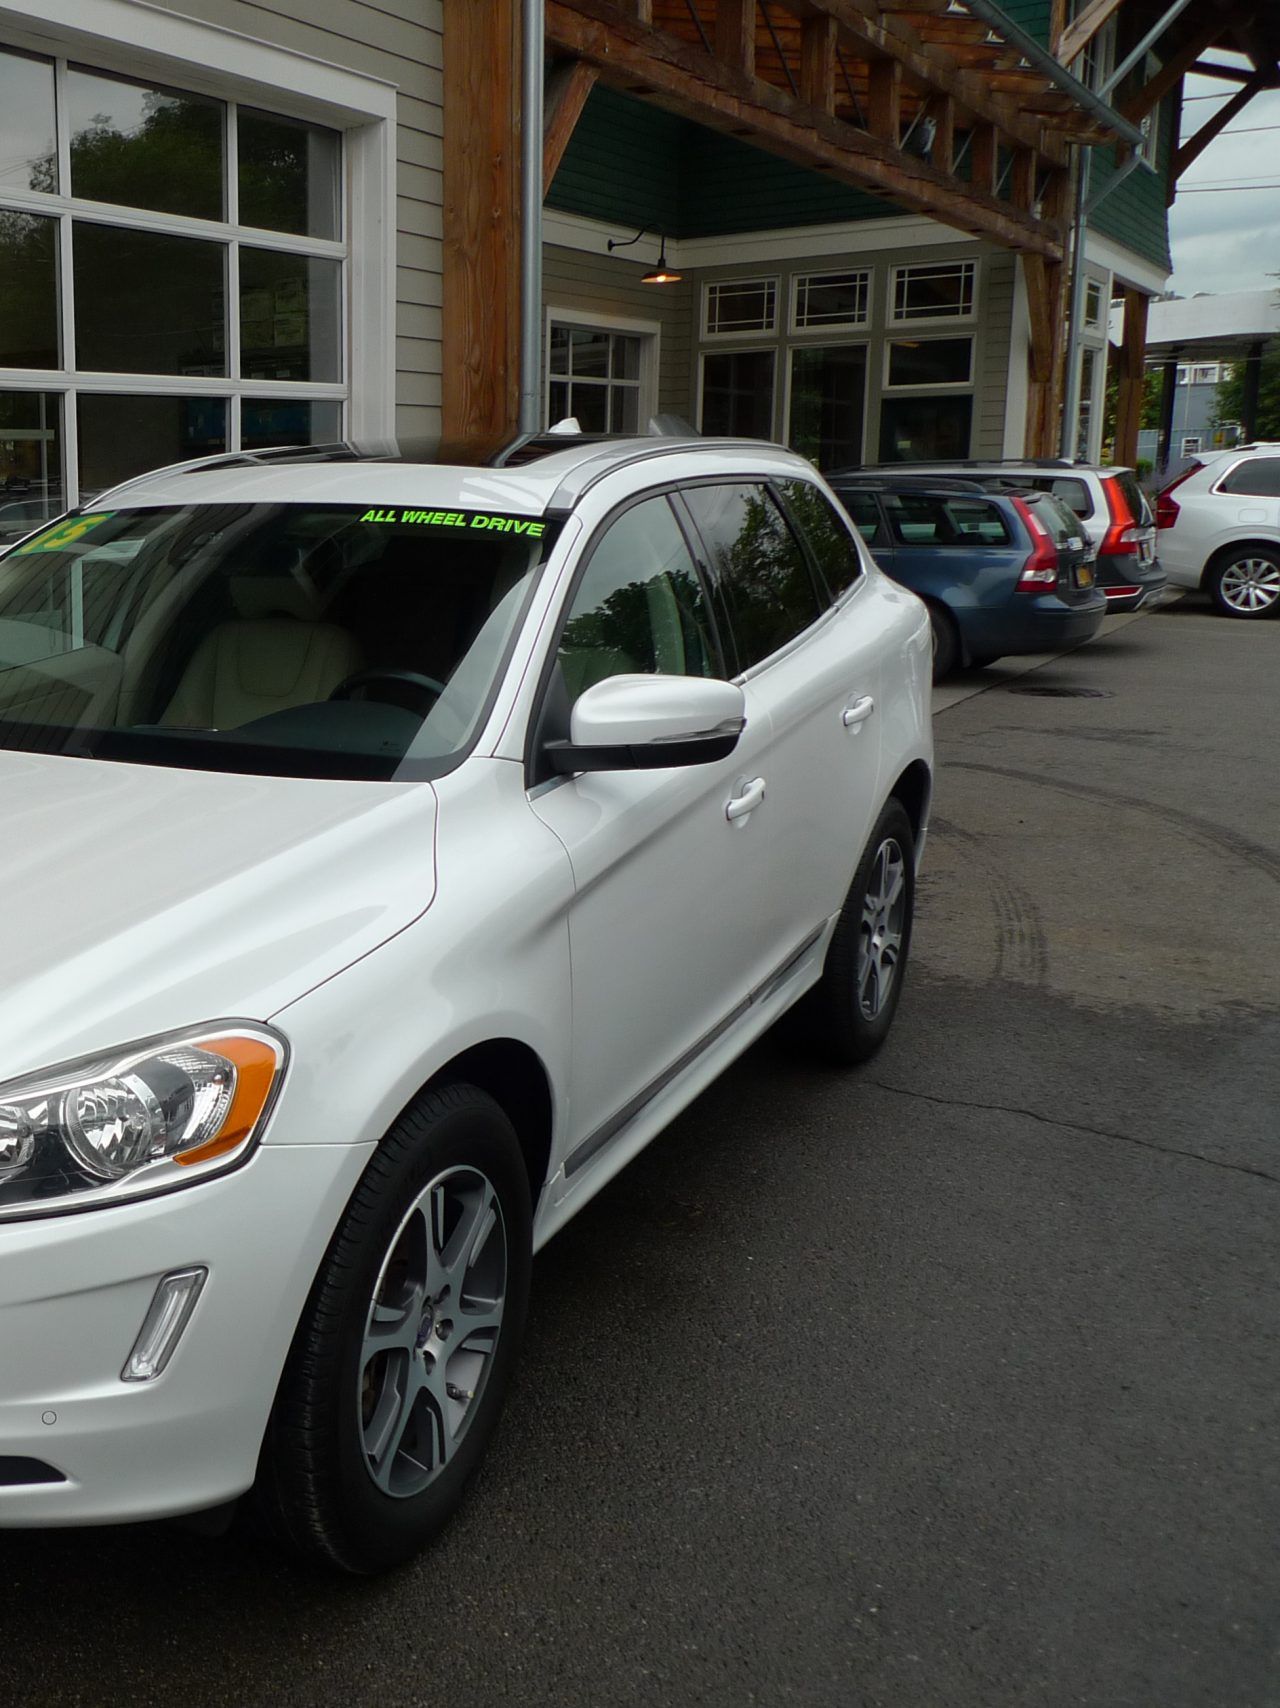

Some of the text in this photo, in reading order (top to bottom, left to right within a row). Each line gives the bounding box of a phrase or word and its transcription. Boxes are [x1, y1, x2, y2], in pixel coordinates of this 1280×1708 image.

[360, 510, 546, 537] ALL WHEEL DRIVE
